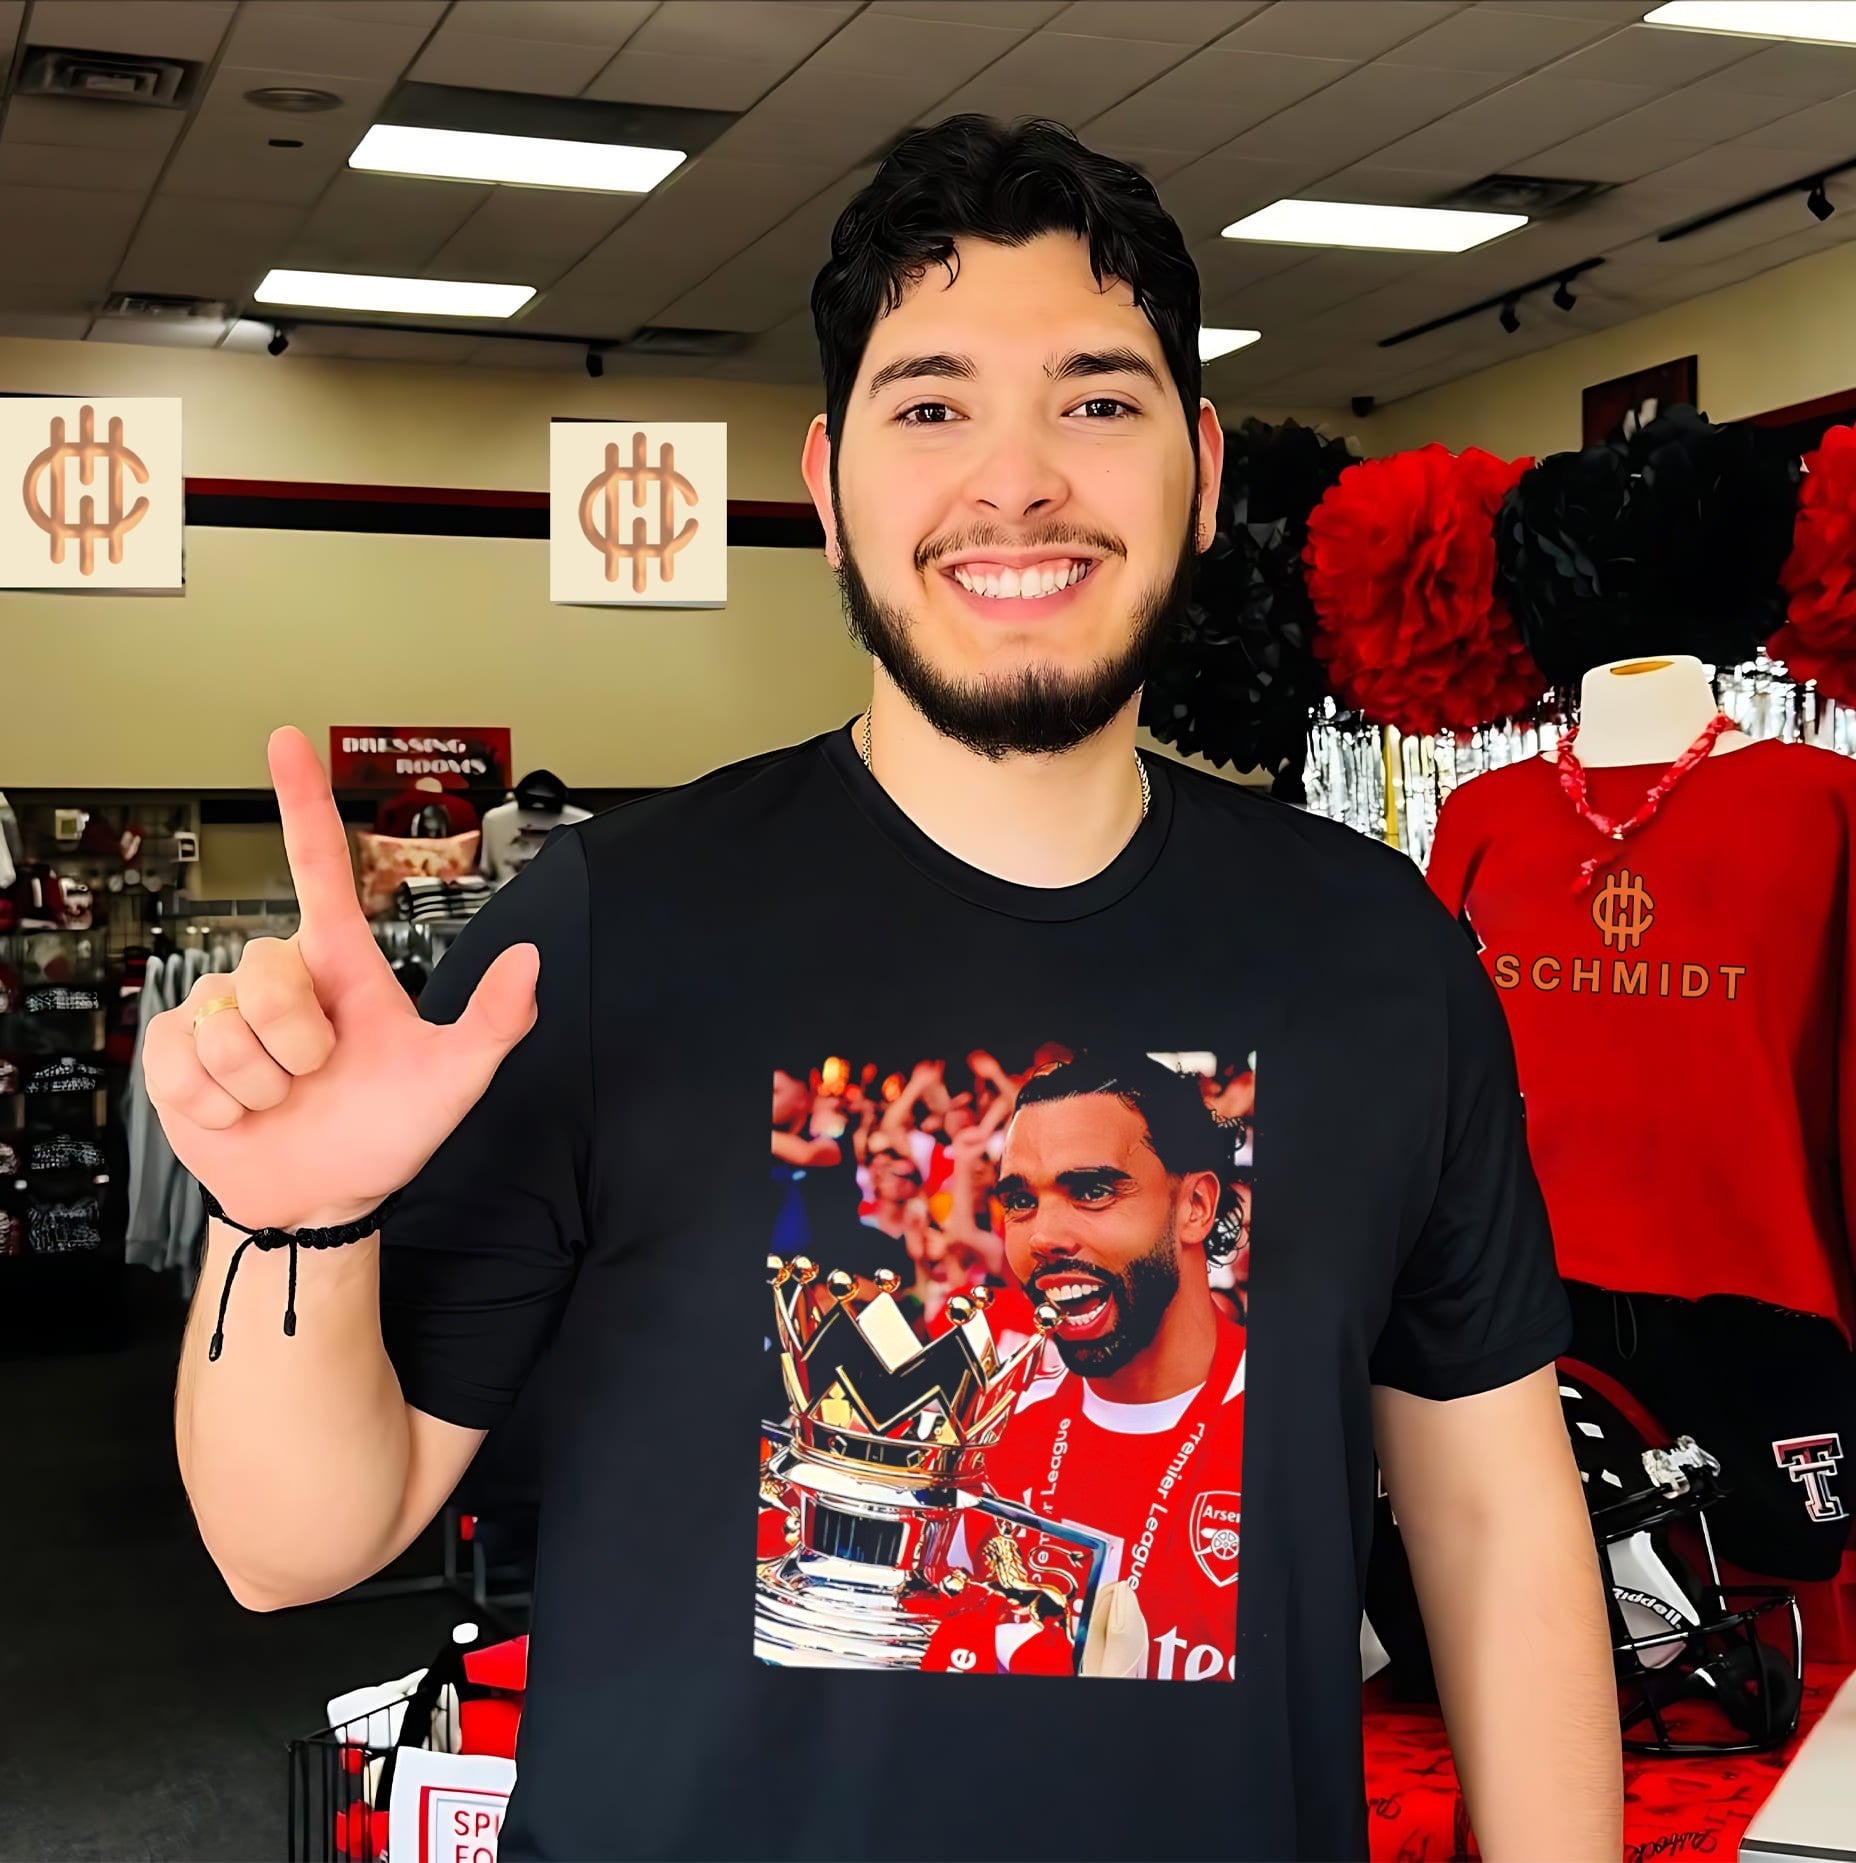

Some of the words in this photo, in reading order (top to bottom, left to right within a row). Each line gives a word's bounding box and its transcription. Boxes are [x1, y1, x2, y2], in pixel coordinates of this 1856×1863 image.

[396, 758, 487, 775] ROOMS
[1493, 953, 1748, 1001] SCHMIDT
[1040, 1417, 1072, 1496] League
[1127, 1501, 1169, 1591] League
